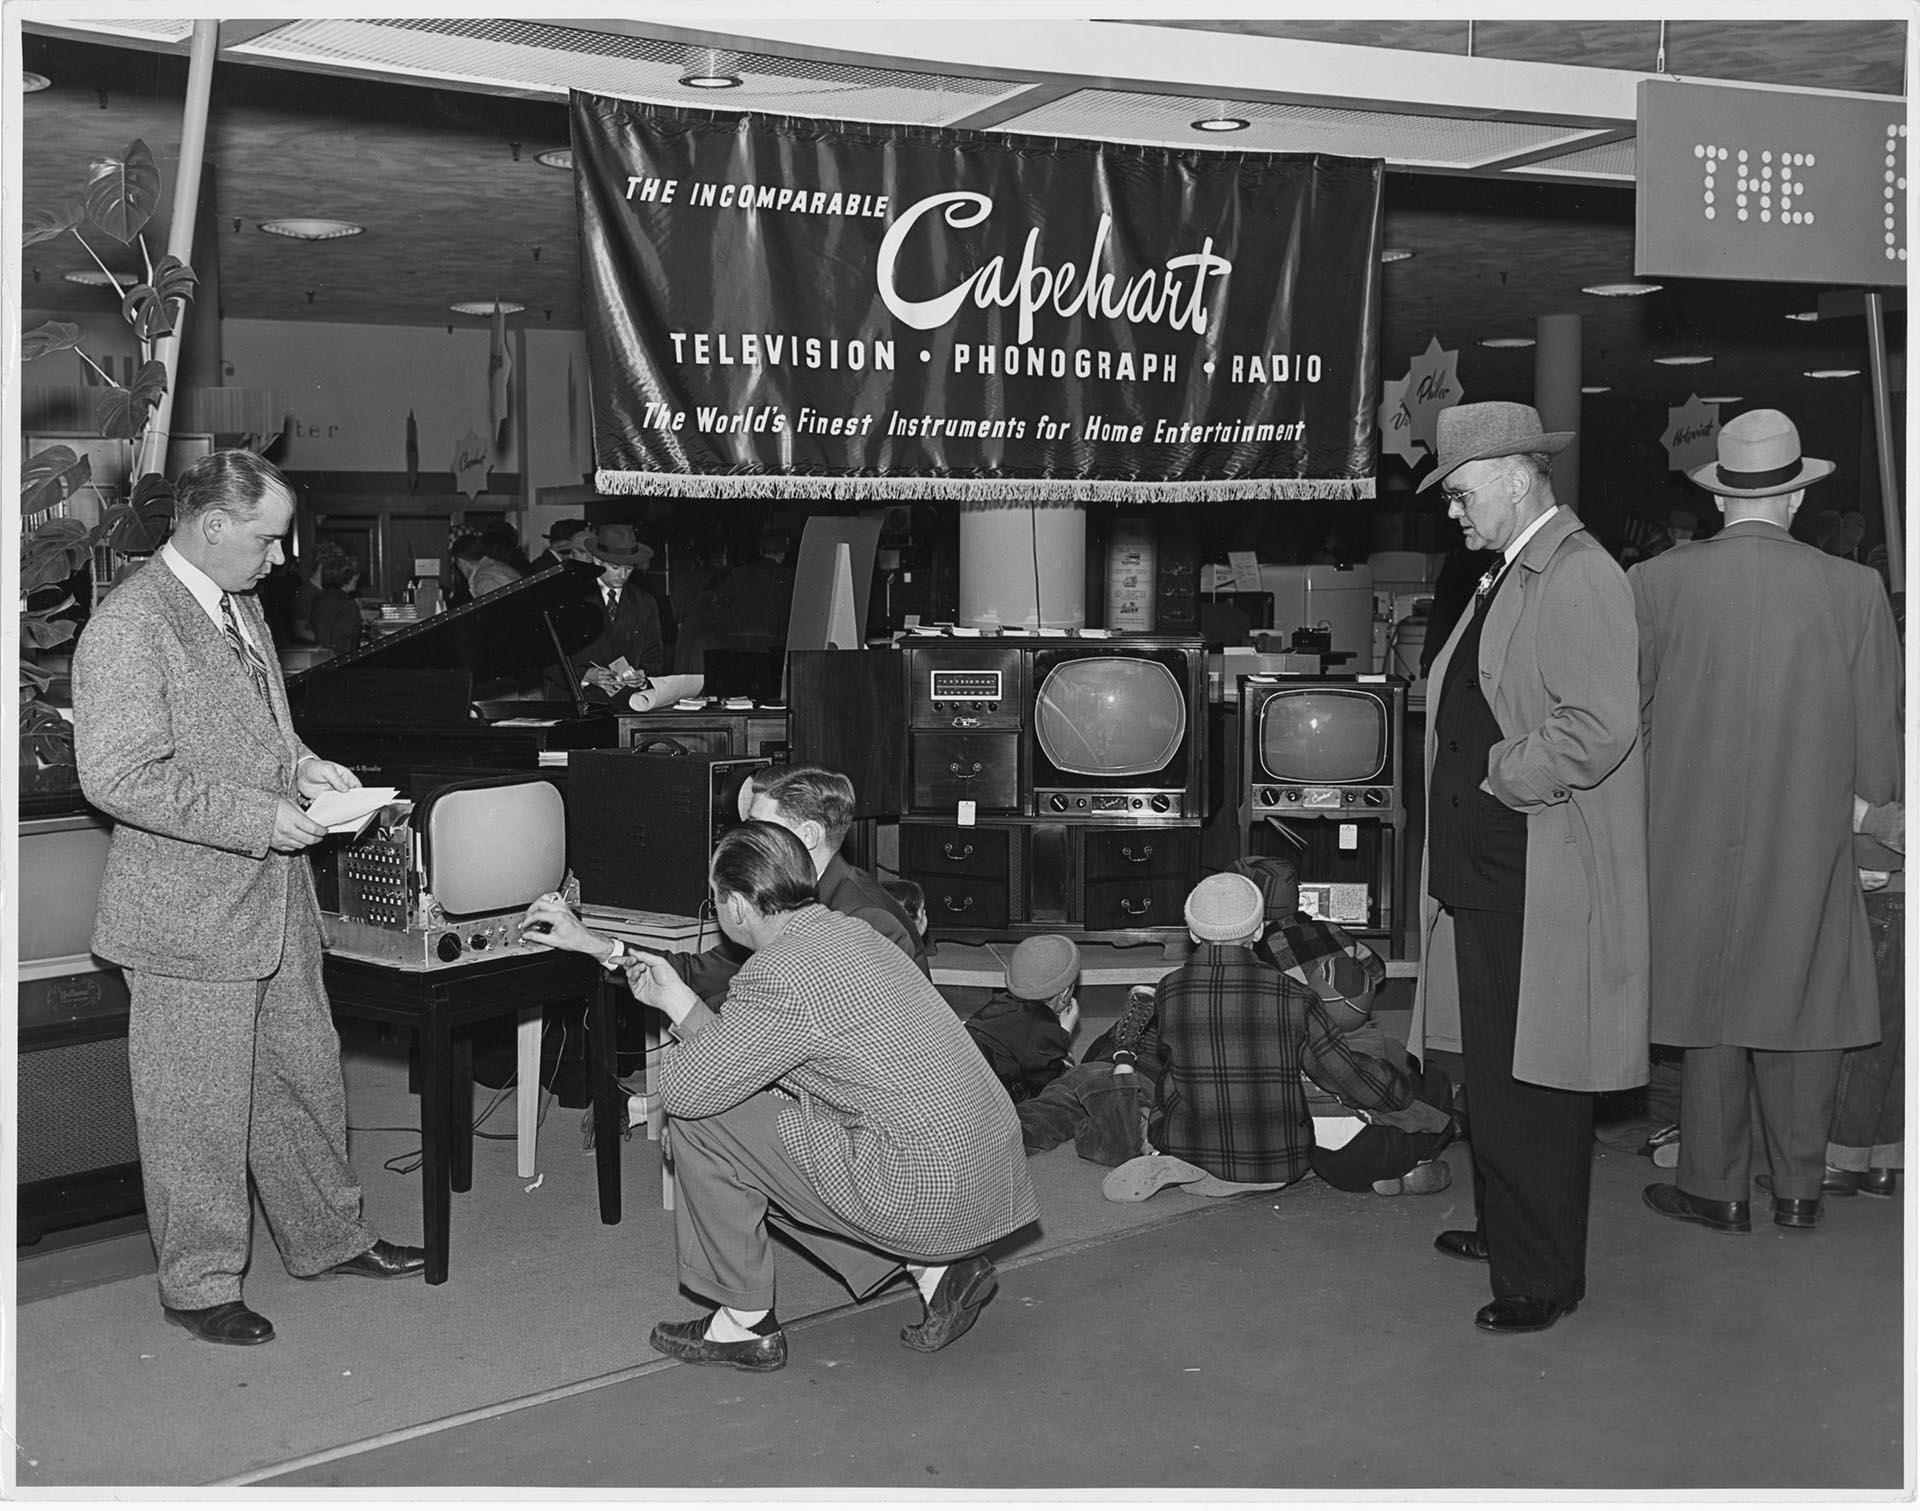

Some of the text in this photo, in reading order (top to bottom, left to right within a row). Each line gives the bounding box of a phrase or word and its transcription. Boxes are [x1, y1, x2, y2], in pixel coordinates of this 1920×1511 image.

[625, 176, 890, 218] THE INCOMPARABLE
[1694, 144, 1815, 225] THE
[877, 191, 1232, 345] Capehart
[670, 333, 1322, 383] TELEVISION PHONOGRAPH RADIO
[642, 402, 1306, 444] The World's Finest Instruments for Home Entertainment
